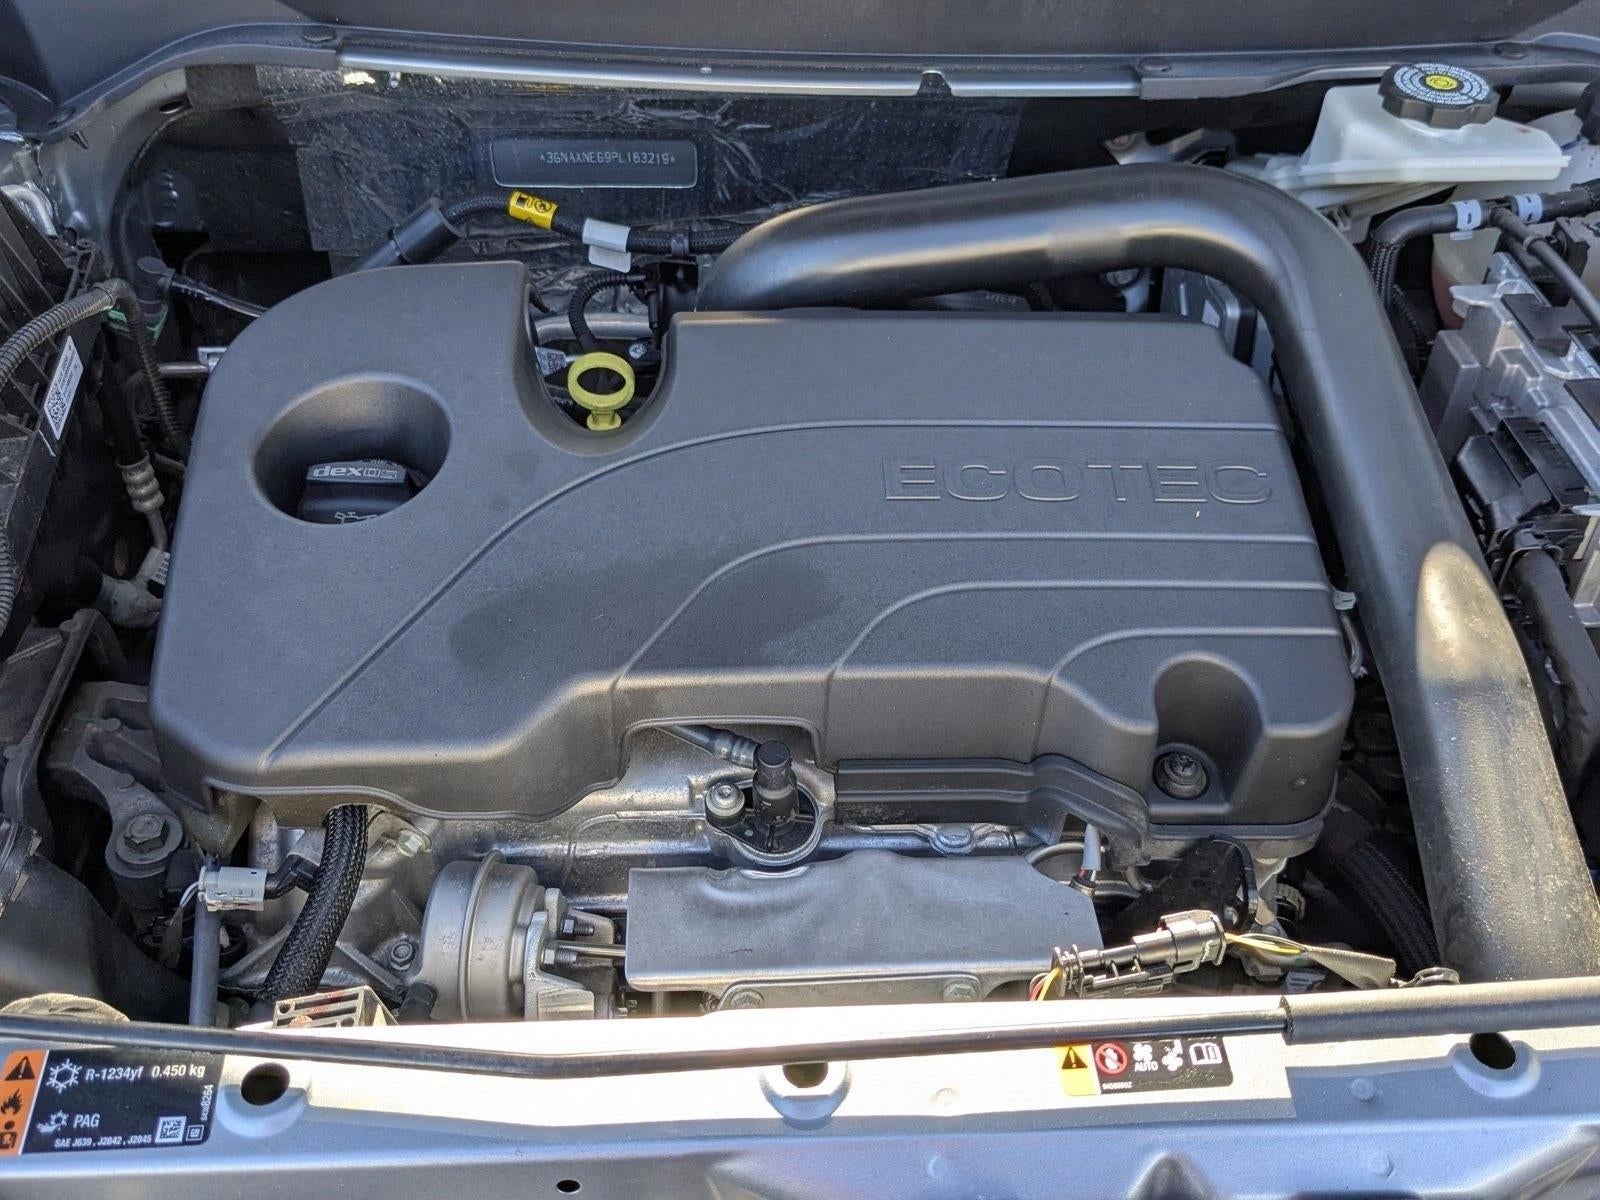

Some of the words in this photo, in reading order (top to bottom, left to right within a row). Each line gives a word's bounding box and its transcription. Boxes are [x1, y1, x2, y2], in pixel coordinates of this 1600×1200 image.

[312, 465, 398, 480] dexos
[881, 459, 1272, 504] ECOTEC
[85, 1066, 144, 1082] R-1234yf
[151, 1065, 186, 1078] 0.450
[189, 1063, 206, 1078] kg
[1134, 1061, 1159, 1072] AUTO
[73, 1113, 100, 1128] PAG
[54, 1138, 71, 1148] SAE
